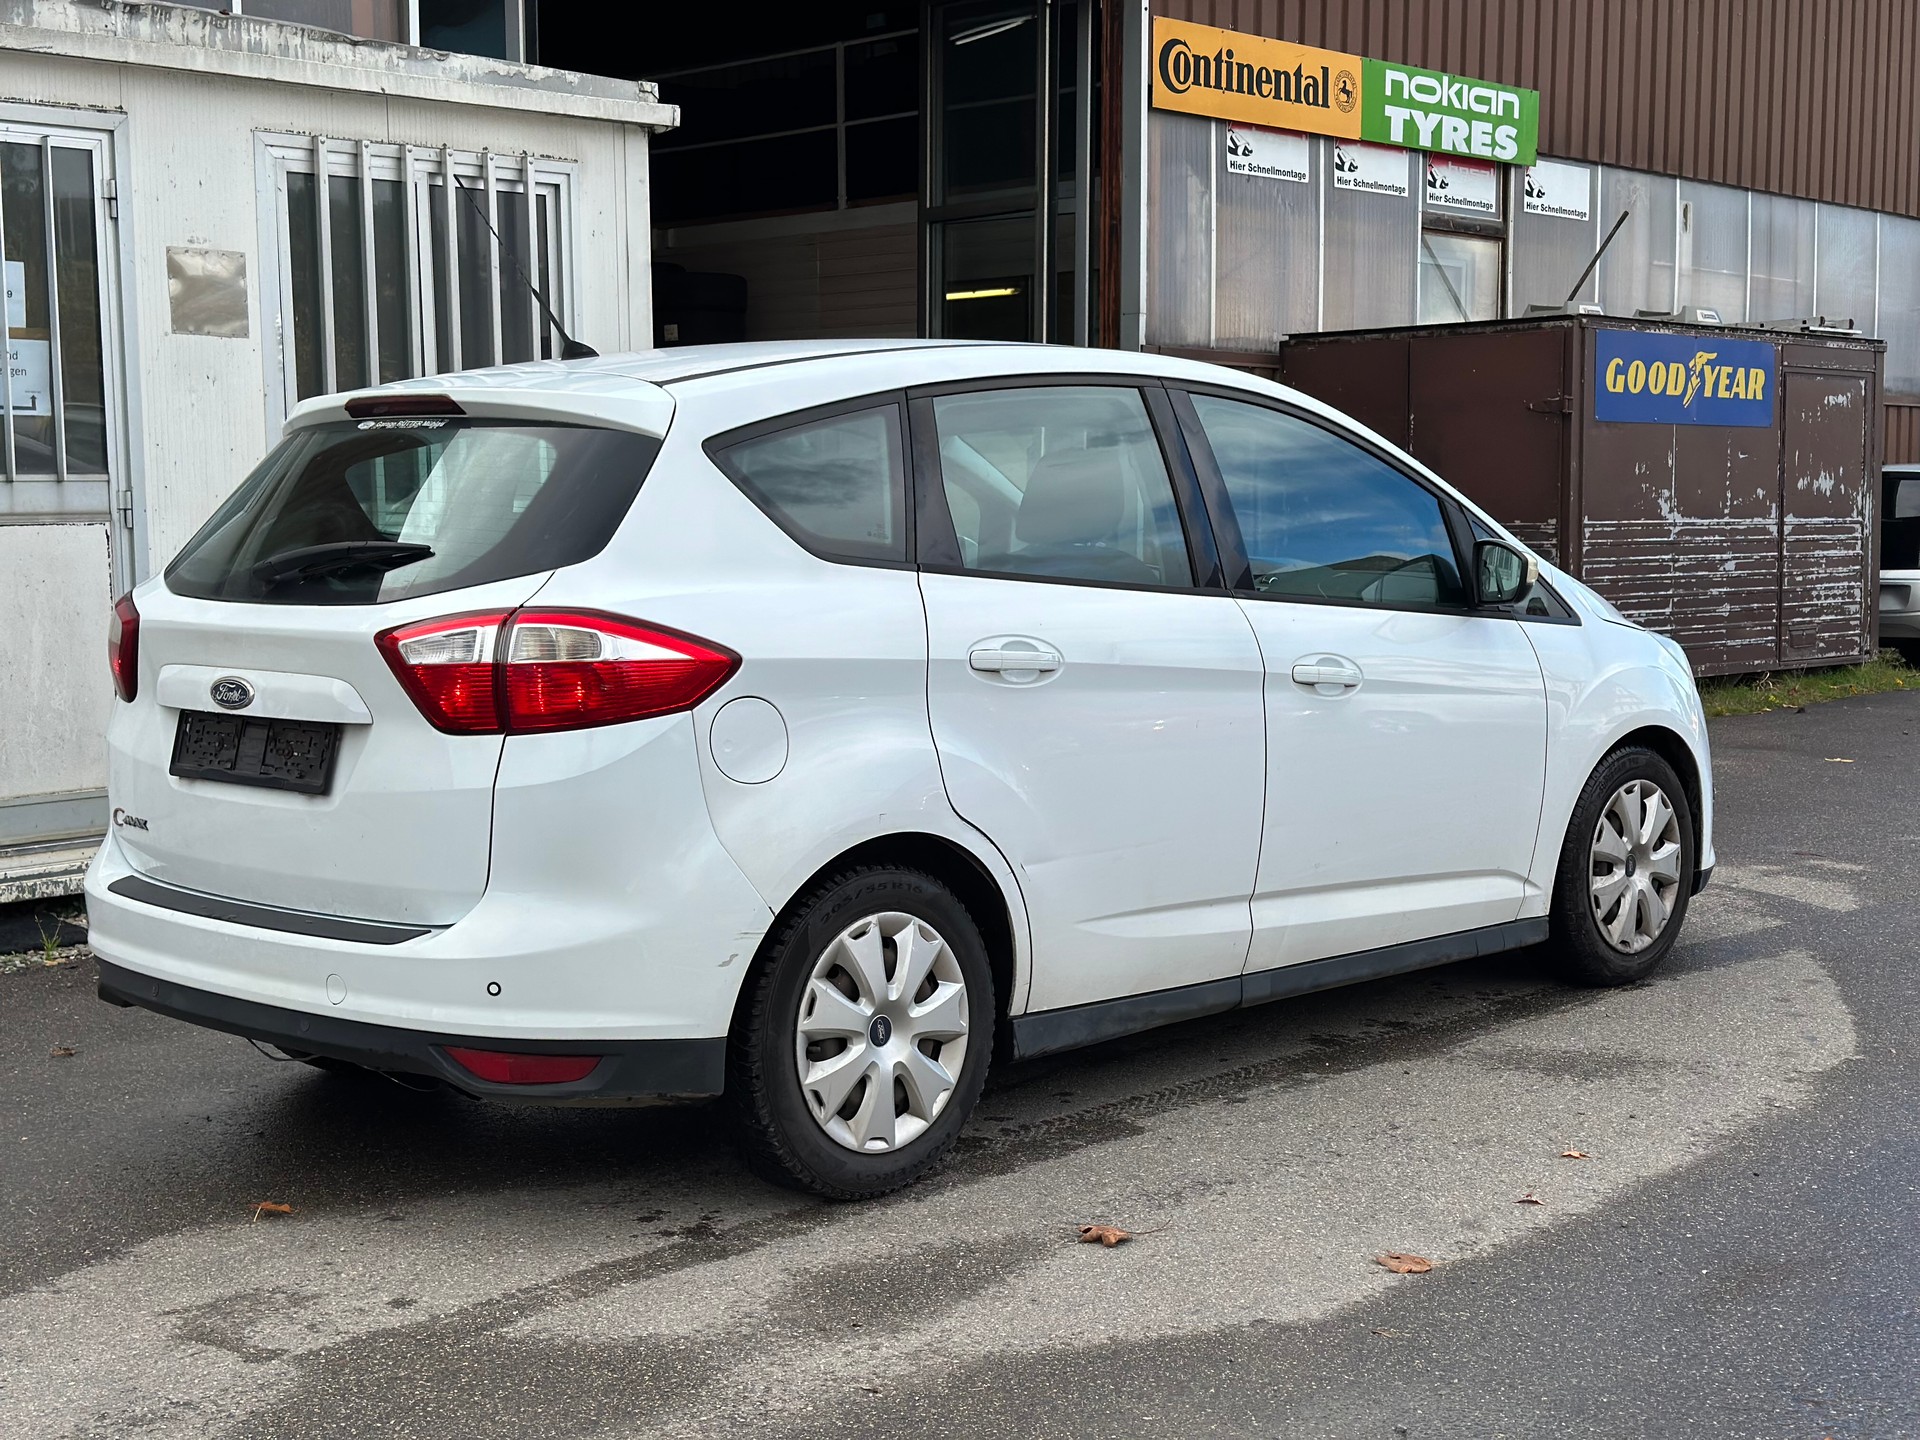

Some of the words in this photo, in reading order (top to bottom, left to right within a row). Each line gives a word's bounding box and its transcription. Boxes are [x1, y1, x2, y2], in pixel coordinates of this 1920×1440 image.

[1159, 38, 1330, 109] Continental
[1385, 69, 1520, 119] nokian
[1384, 105, 1518, 160] TYRES
[1229, 160, 1246, 171] Hier
[1247, 162, 1307, 181] Schnellmontage
[1336, 175, 1352, 186] Hier
[1353, 177, 1407, 195] Schnellmontage
[1428, 192, 1443, 203] Hier
[1443, 194, 1494, 211] Schnellmontage
[1526, 201, 1540, 211] Hier
[1540, 203, 1588, 219] Schnellmontage
[216, 682, 242, 702] Ford
